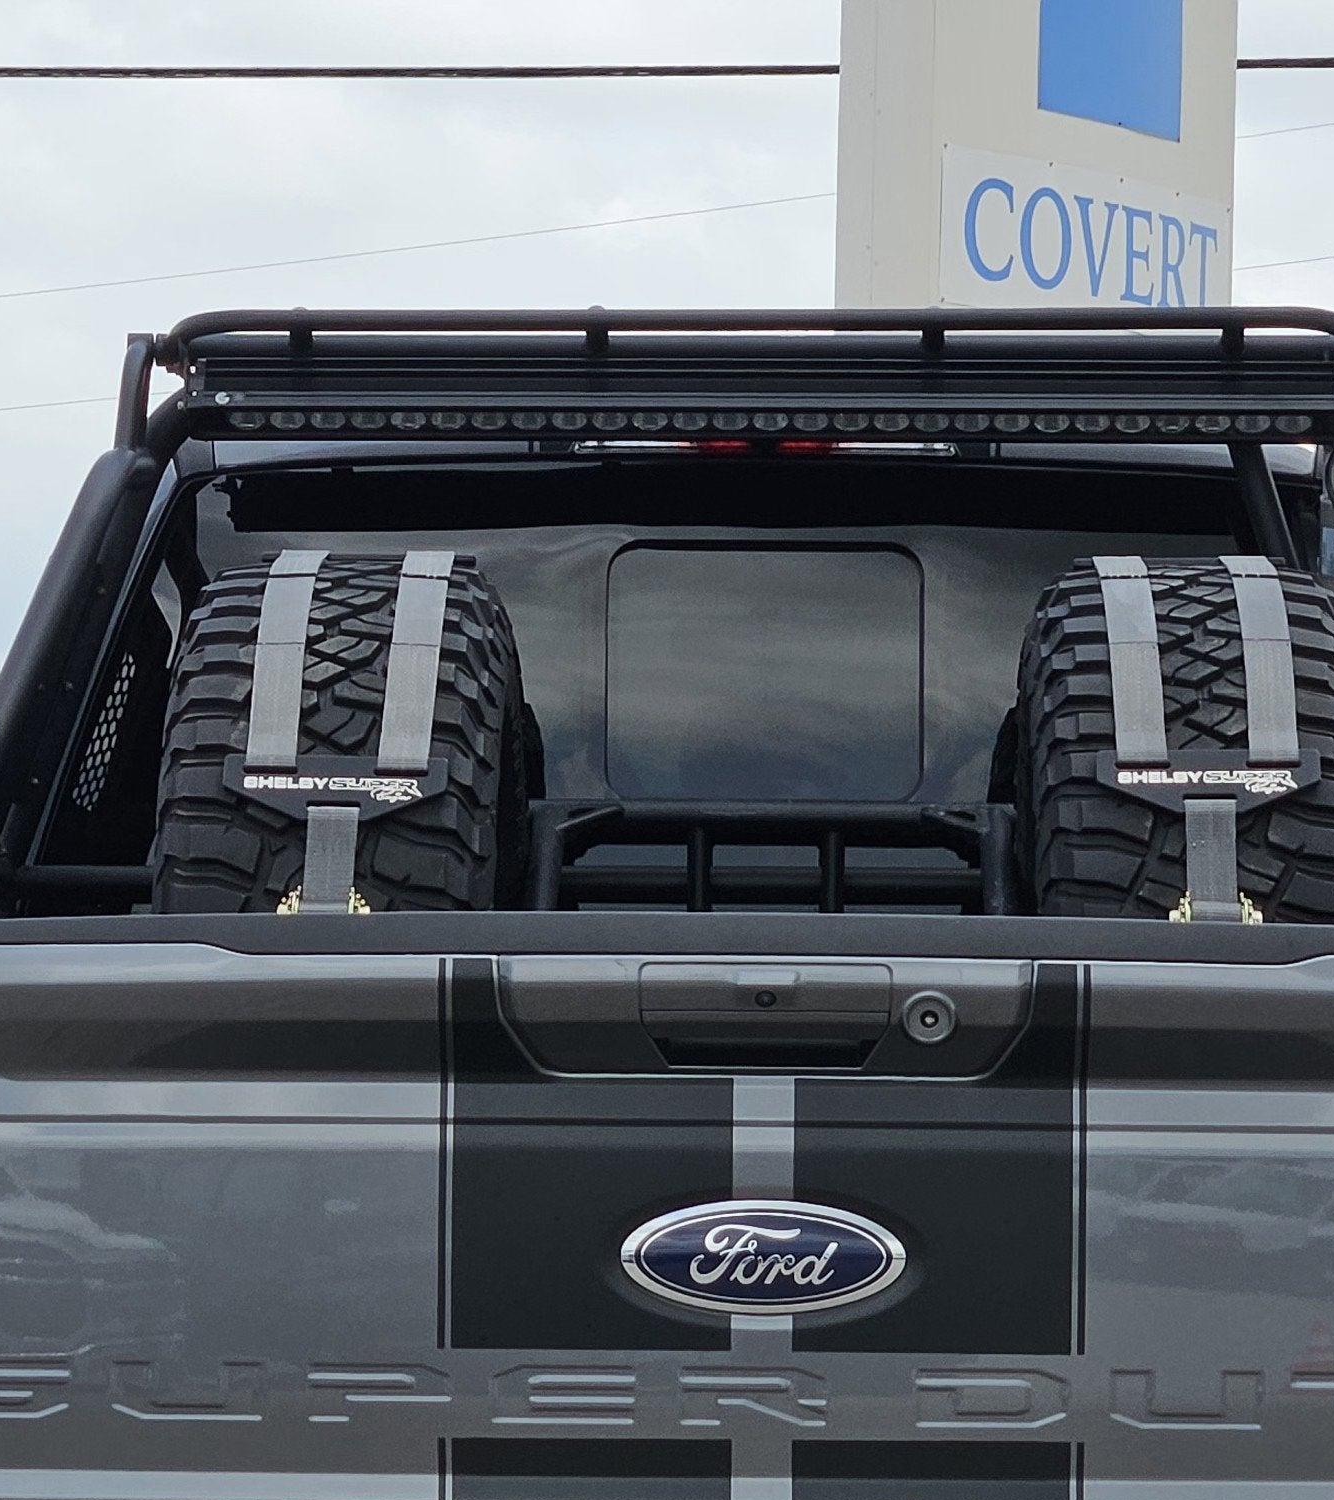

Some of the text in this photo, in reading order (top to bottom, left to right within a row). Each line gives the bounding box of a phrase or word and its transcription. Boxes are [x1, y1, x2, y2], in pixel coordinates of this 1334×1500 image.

[964, 178, 1218, 308] COVERT
[243, 776, 329, 790] SHELBY
[1117, 770, 1203, 784] SHELBY
[689, 1223, 839, 1285] Ford
